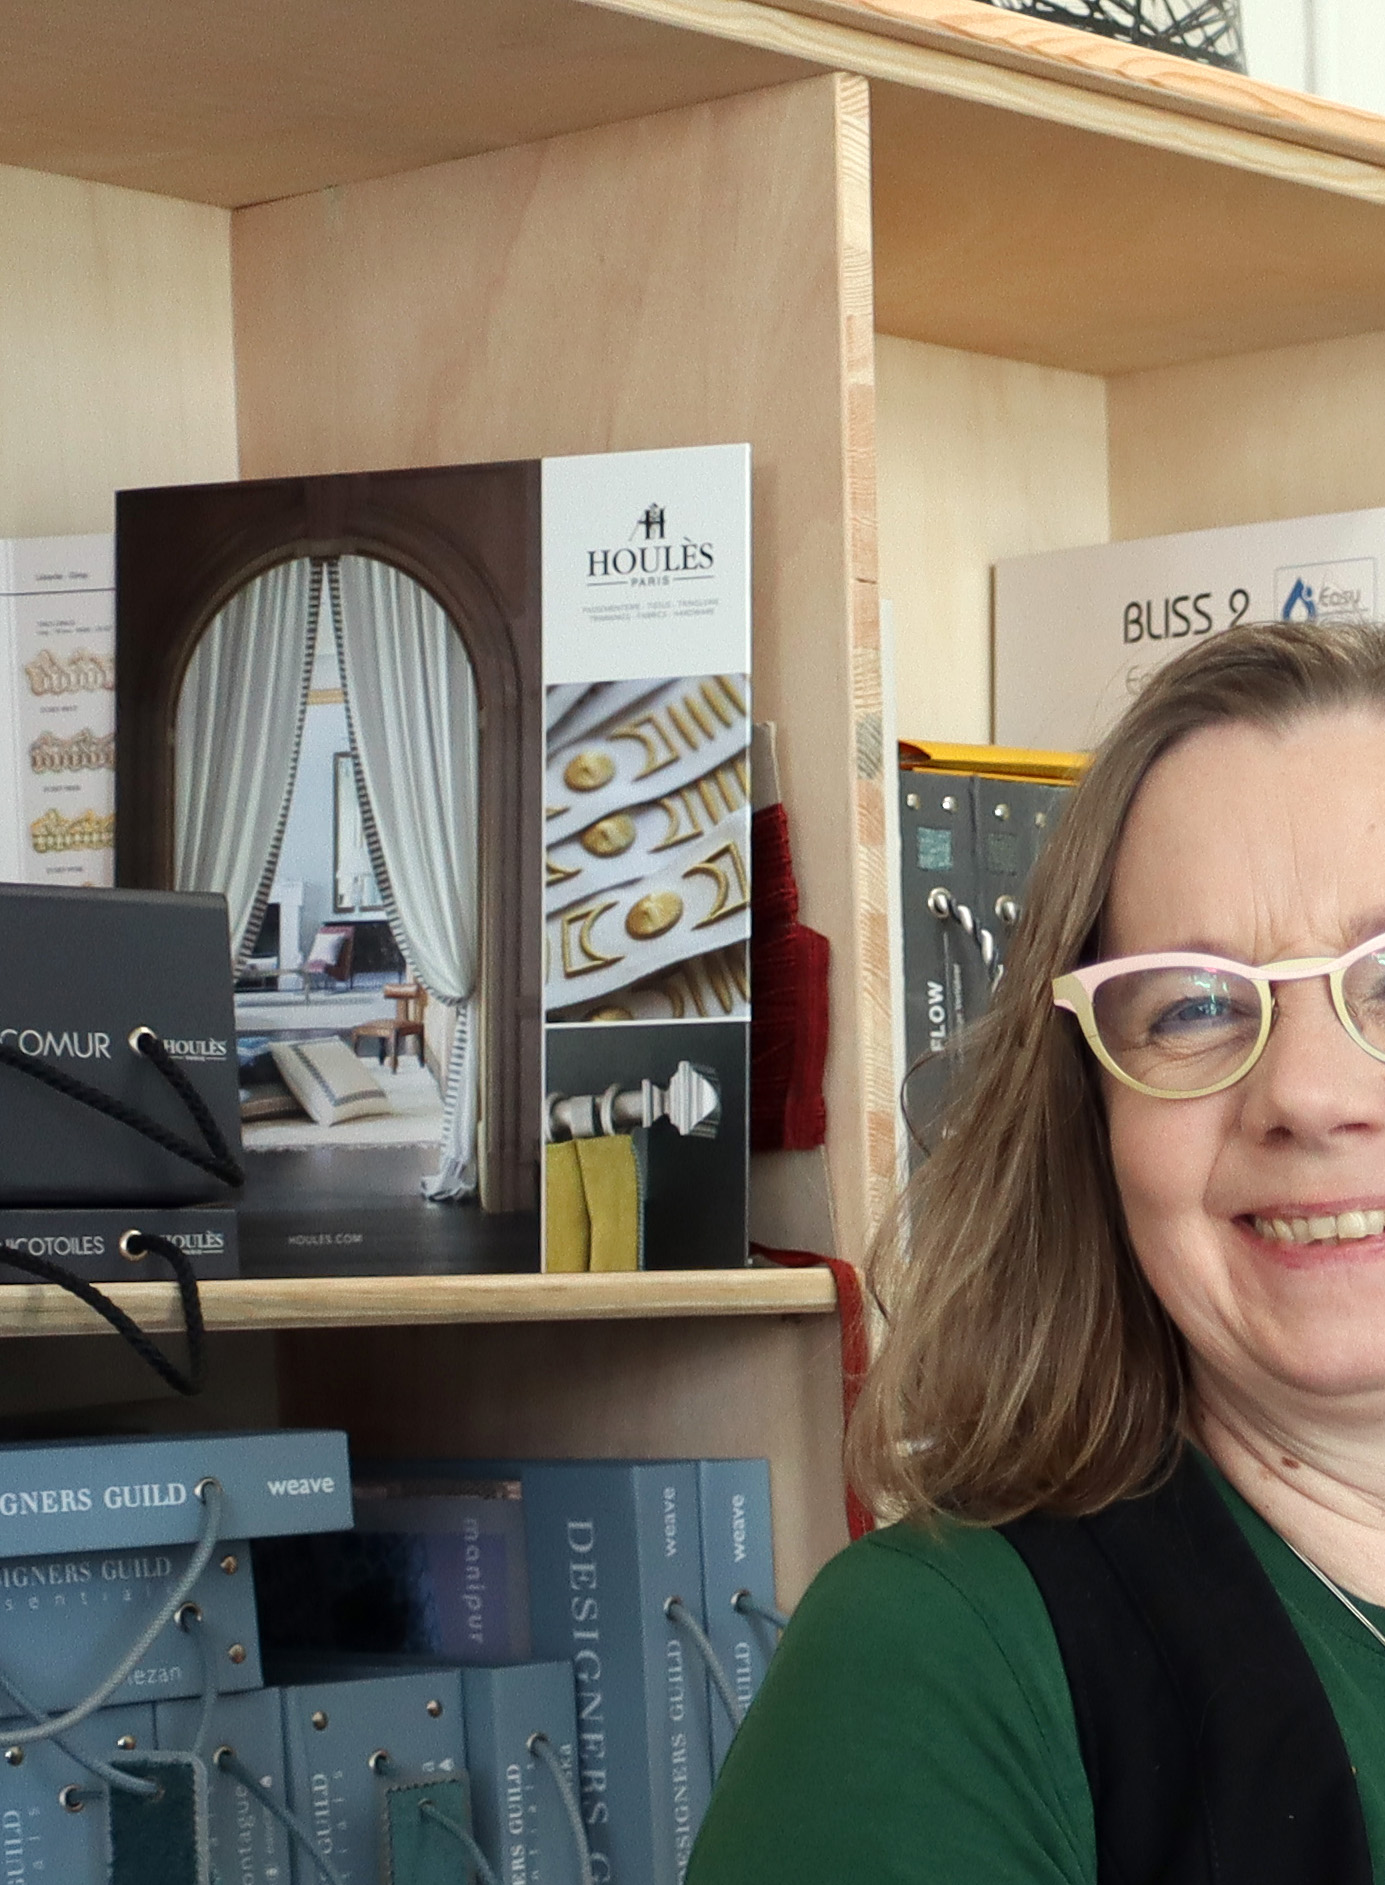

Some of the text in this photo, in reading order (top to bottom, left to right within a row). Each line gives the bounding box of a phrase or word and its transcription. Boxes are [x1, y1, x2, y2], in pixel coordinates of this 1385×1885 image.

[587, 536, 714, 577] HOULÈS
[630, 575, 671, 587] PARIS
[1123, 593, 1213, 644] BLISS
[163, 1037, 227, 1056] HOULÈS
[927, 981, 946, 1053] FLOW
[103, 1483, 187, 1509] GUILD
[266, 1476, 335, 1496] weave
[662, 1486, 677, 1558] weave
[731, 1493, 748, 1563] weave
[0, 1556, 173, 1588] IGNERS GUILD
[462, 1517, 486, 1643] manipur
[566, 1518, 609, 1825] DESIGNERS
[666, 1639, 685, 1721] GUILD
[311, 1773, 334, 1855] GUILD
[506, 1764, 524, 1835] GUILD
